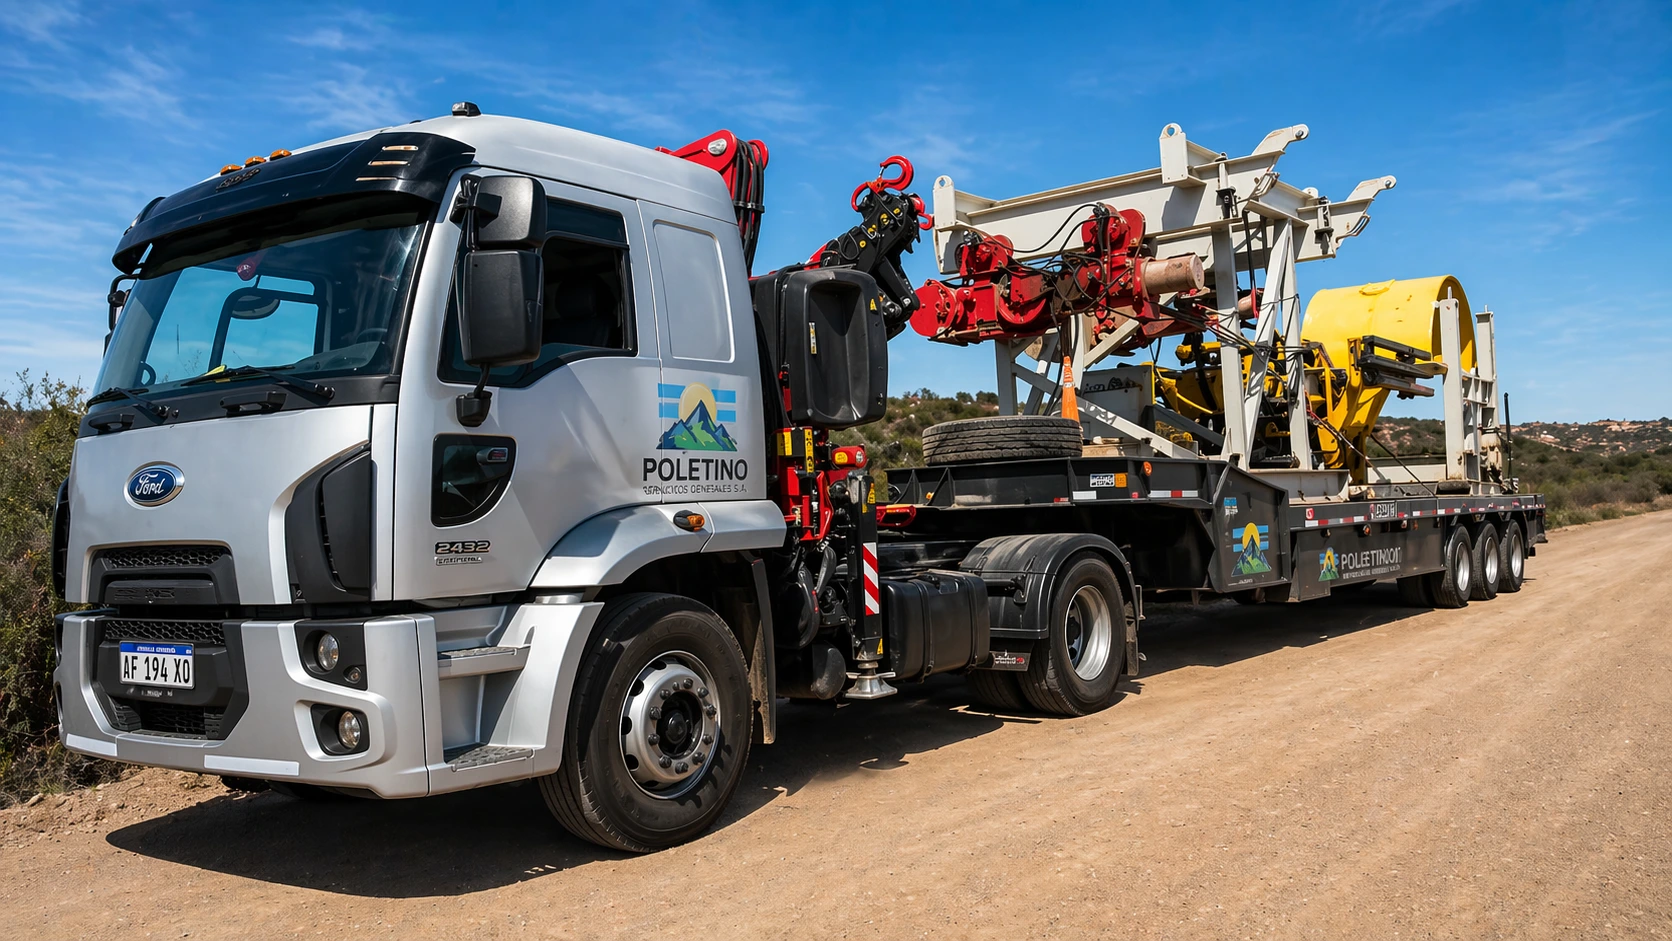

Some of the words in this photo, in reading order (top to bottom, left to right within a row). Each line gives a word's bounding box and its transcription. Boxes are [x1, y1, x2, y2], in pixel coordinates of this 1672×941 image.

[643, 457, 748, 481] POLETINO
[135, 473, 166, 495] Ford
[436, 541, 490, 554] 2432
[123, 655, 139, 679] AF
[144, 656, 169, 682] 194
